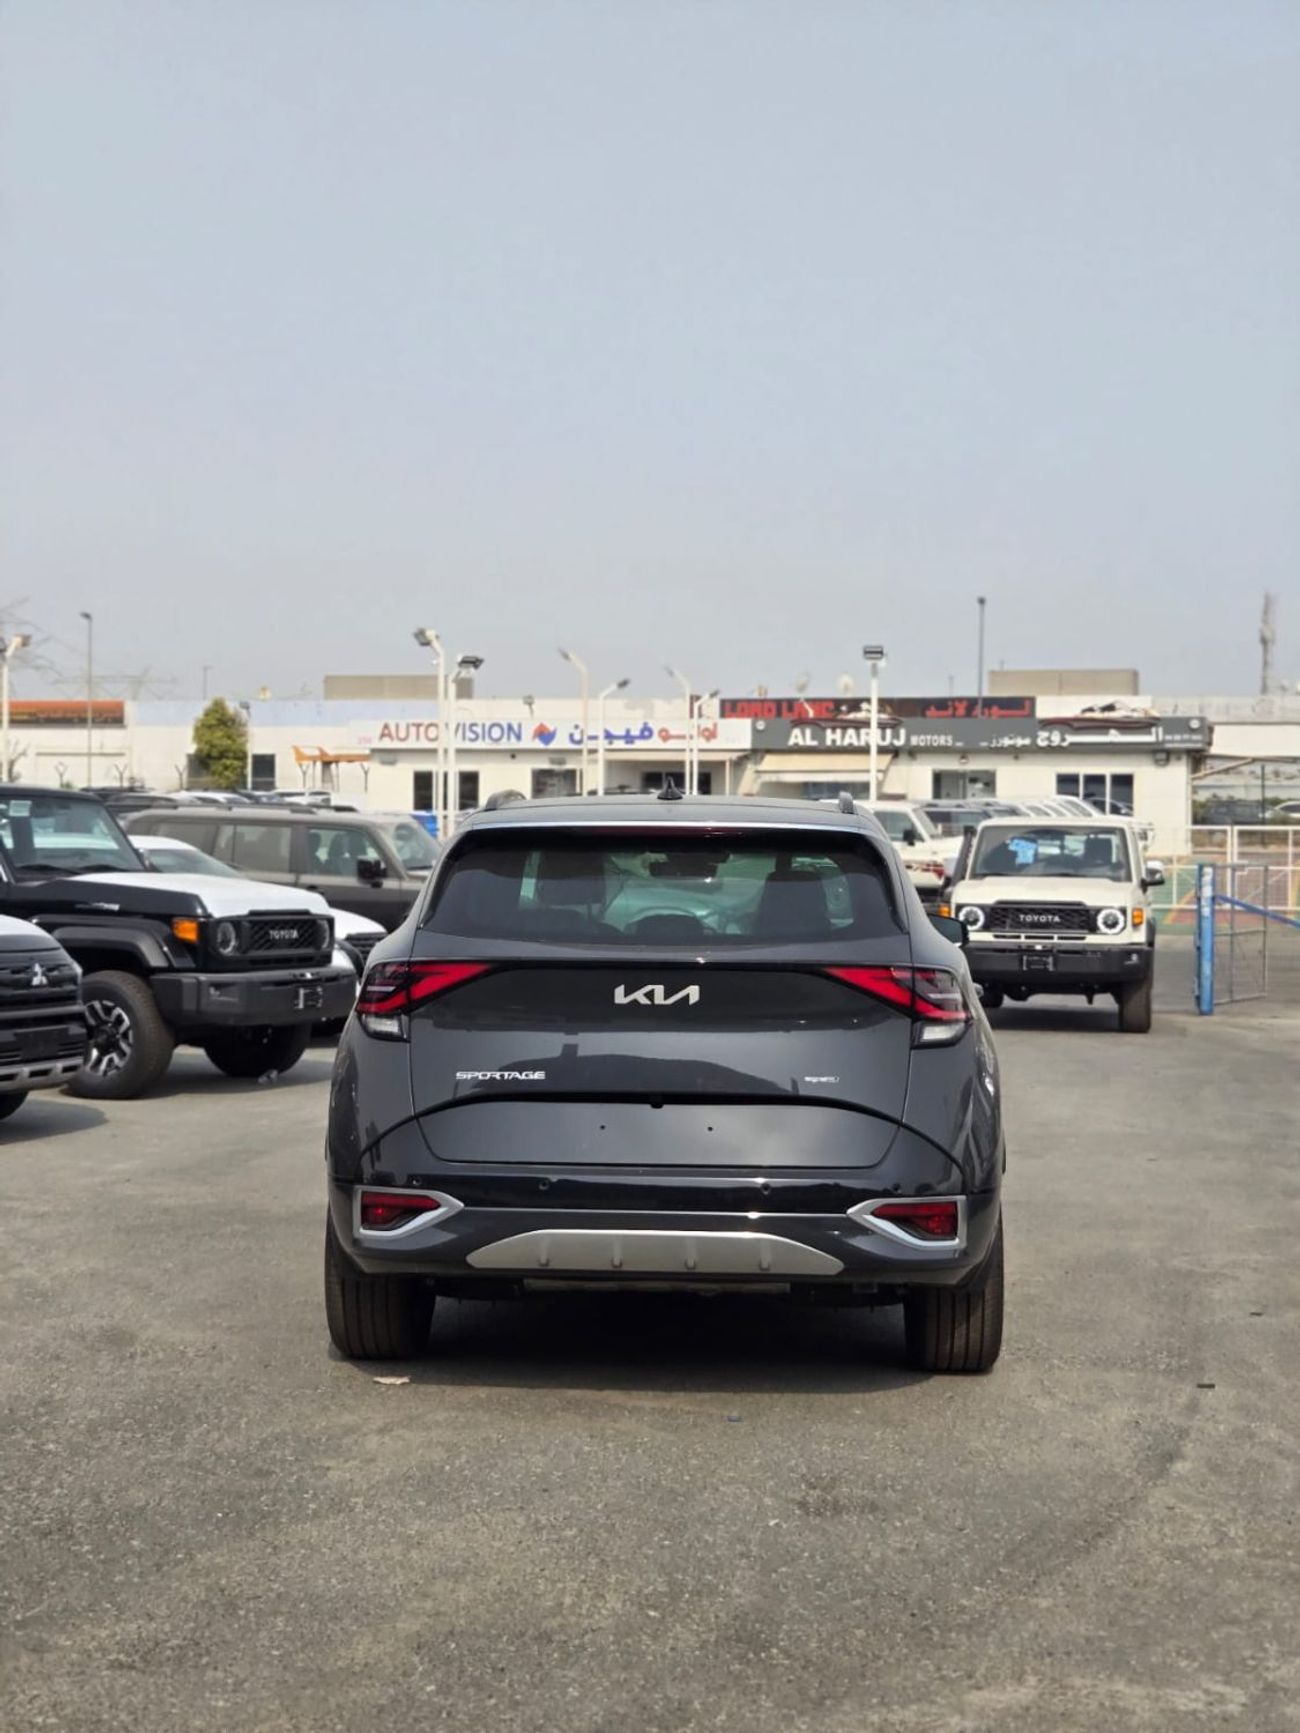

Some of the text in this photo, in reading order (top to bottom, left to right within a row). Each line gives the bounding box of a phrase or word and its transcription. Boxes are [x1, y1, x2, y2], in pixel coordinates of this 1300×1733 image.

[379, 722, 440, 742] AUTO
[444, 722, 522, 742] VISION
[788, 728, 953, 746] AL HARUJ MOTORS
[1019, 914, 1060, 923] TOYOTA
[269, 929, 299, 940] TOYOTA
[614, 984, 700, 1006] KIA
[456, 1071, 546, 1080] SPORTAGE
